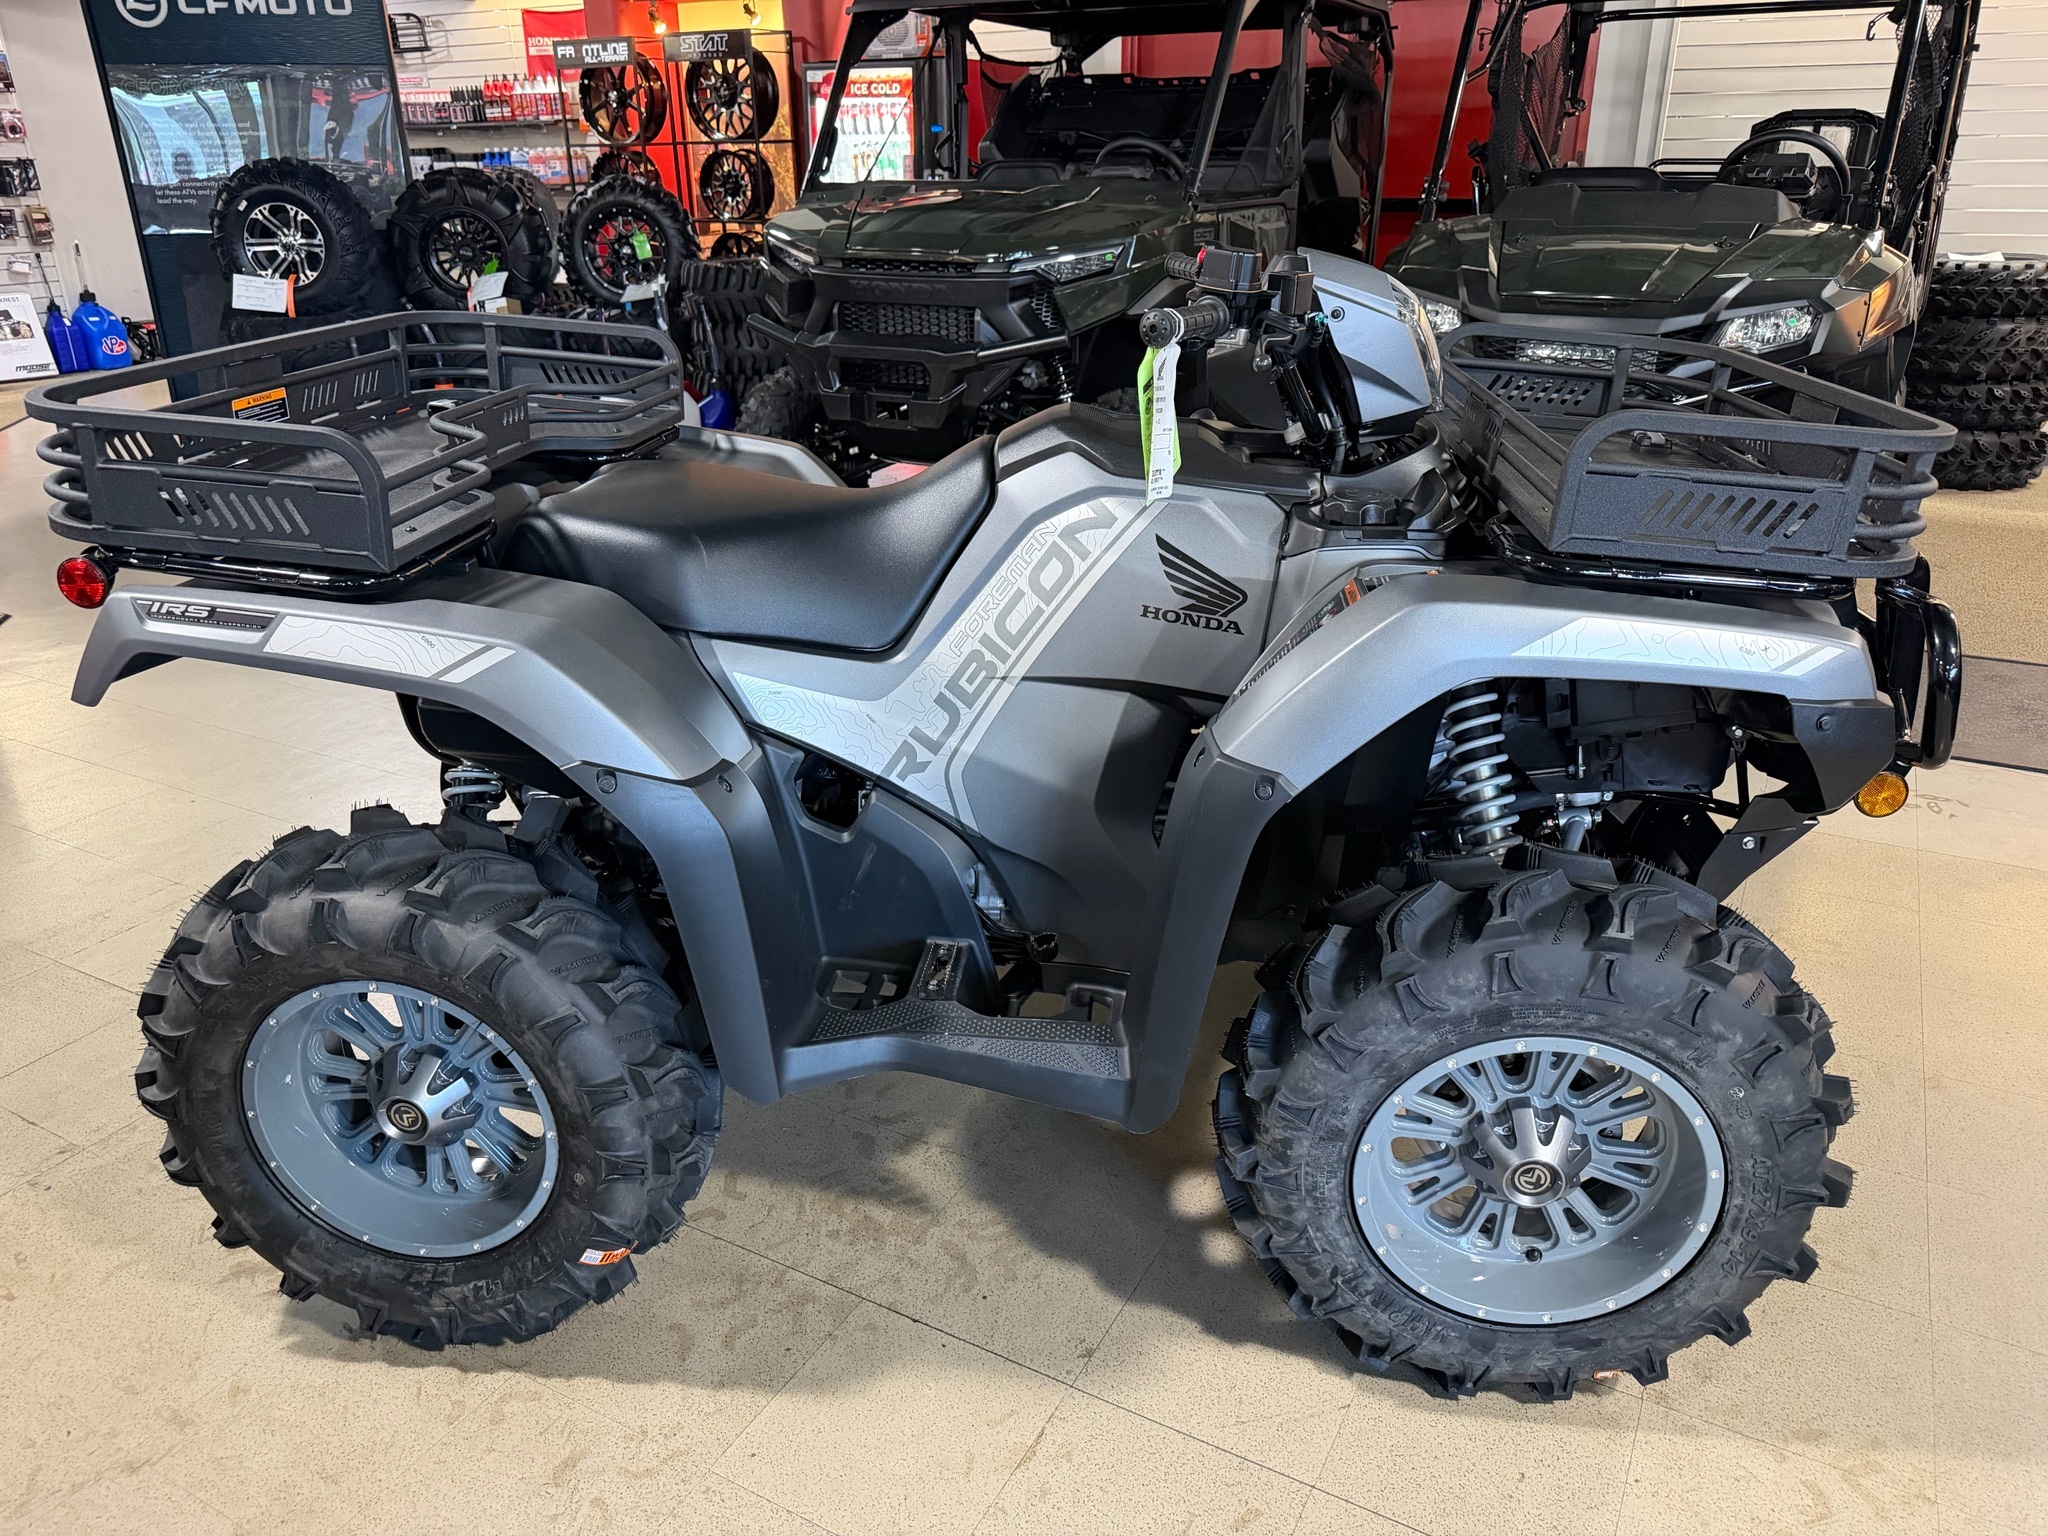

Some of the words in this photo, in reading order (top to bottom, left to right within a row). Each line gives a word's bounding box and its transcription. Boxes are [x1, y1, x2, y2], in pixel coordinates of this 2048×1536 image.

[177, 0, 353, 16] CFMOTO
[680, 33, 728, 52] STAT
[850, 83, 868, 94] ICE
[870, 83, 900, 94] COLD
[238, 120, 250, 128] and
[183, 198, 199, 206] way.
[949, 519, 1058, 658] FOREMAN
[150, 602, 212, 618] IRS
[1140, 604, 1245, 636] HONDA
[420, 634, 437, 650] 6800
[880, 497, 1119, 782] RUBICON
[1739, 646, 1756, 657] 6307
[1552, 906, 1576, 946] VAMPIRE
[551, 954, 601, 976] VAMPIRE
